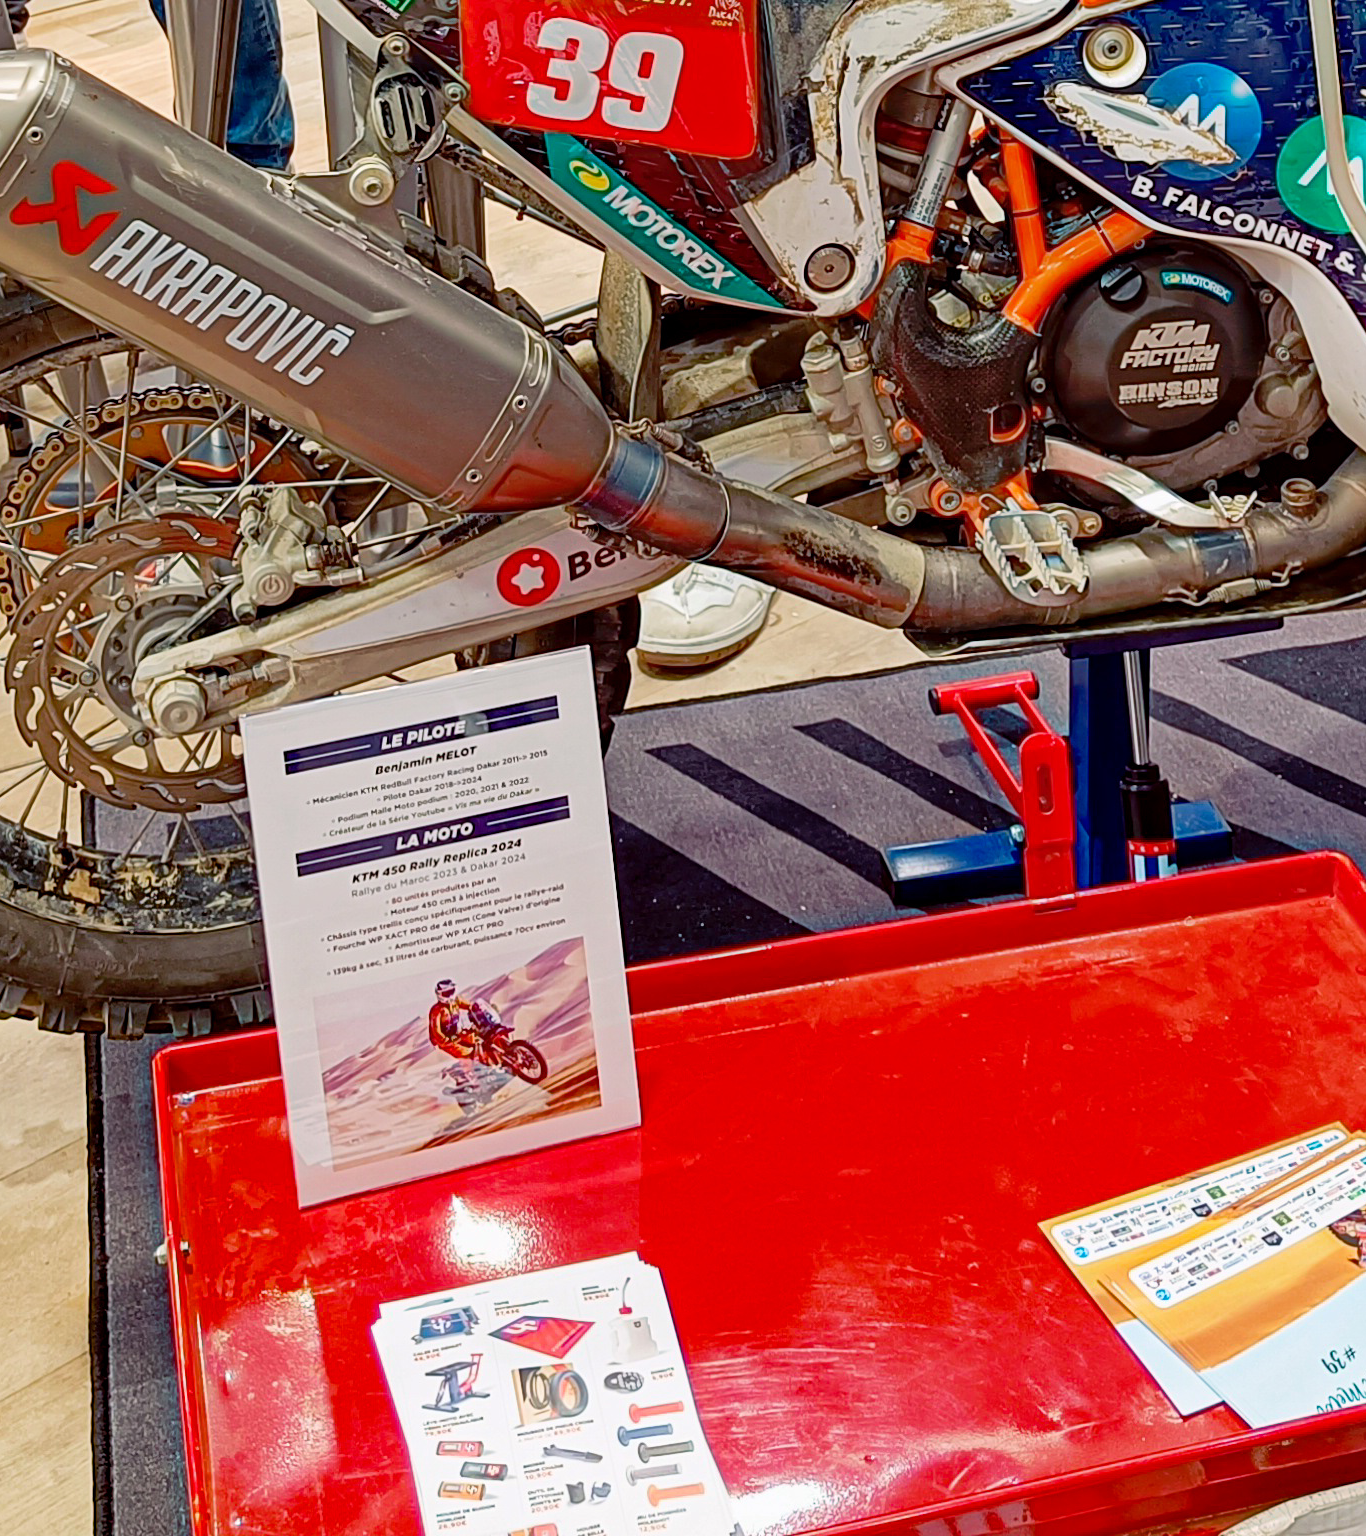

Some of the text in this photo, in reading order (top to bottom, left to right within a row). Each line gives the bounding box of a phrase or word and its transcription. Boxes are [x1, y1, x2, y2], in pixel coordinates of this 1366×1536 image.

[526, 17, 685, 132] 39
[600, 183, 739, 290] MOTOREX
[1131, 175, 1158, 202] B.
[1162, 183, 1334, 263] FALCONNET
[1333, 250, 1357, 274] &
[1182, 273, 1231, 303] MOTOREX
[1130, 320, 1211, 351] KTM
[1119, 344, 1221, 370] FACTORY
[1118, 377, 1220, 401] HINSON
[381, 719, 466, 751] LE PILOTE
[375, 745, 478, 776] Benjamin MELOT
[312, 788, 359, 805] Mécanicien
[360, 784, 379, 796] KTM
[379, 778, 412, 792] RedBull
[413, 771, 445, 786] Factory
[446, 765, 475, 780] Racing
[476, 760, 501, 774] Dakar
[529, 749, 548, 760] 2015
[382, 790, 408, 803] Pilote
[408, 785, 433, 798] Dakar
[395, 821, 475, 852] LA MOTO
[350, 885, 383, 899] Rallye
[399, 874, 431, 889] Maroc
[432, 867, 459, 881] 2023
[470, 858, 499, 873] Dakar
[501, 852, 527, 866] 2024
[351, 837, 523, 885] KTM 450 Rally Replica 2024
[404, 889, 430, 903] unités
[430, 881, 470, 899] produites
